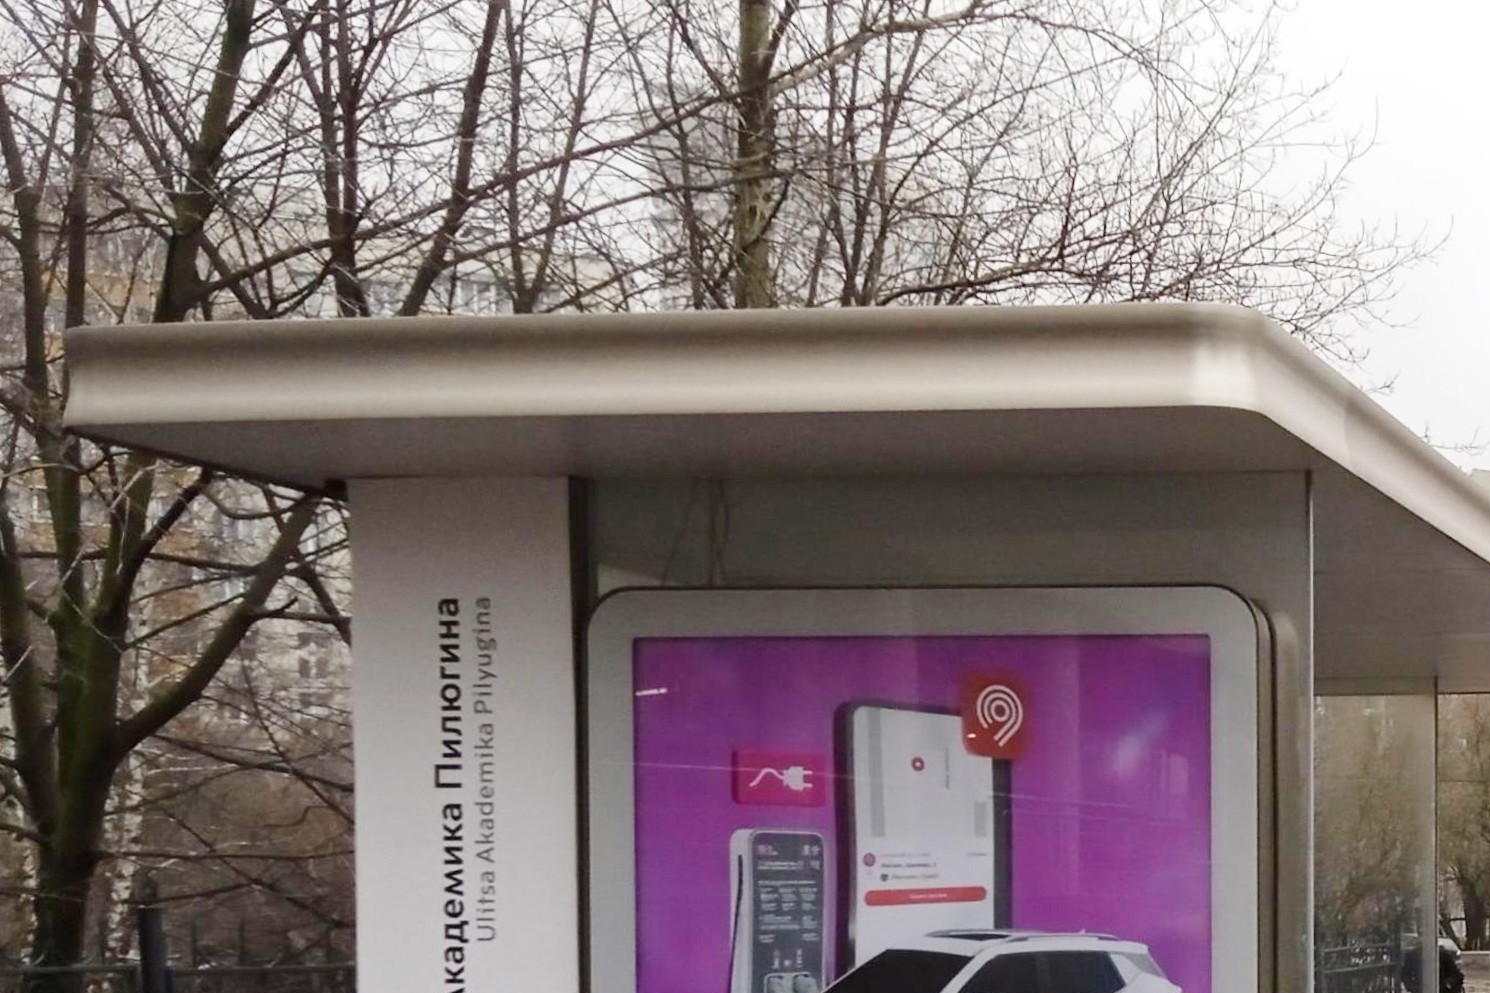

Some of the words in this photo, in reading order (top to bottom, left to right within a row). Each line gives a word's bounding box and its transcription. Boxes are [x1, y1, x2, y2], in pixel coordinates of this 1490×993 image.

[434, 598, 463, 789] Пилюгина
[471, 597, 499, 714] Pilyugina
[472, 723, 496, 864] Akademika
[475, 871, 497, 942] Ulitsa
